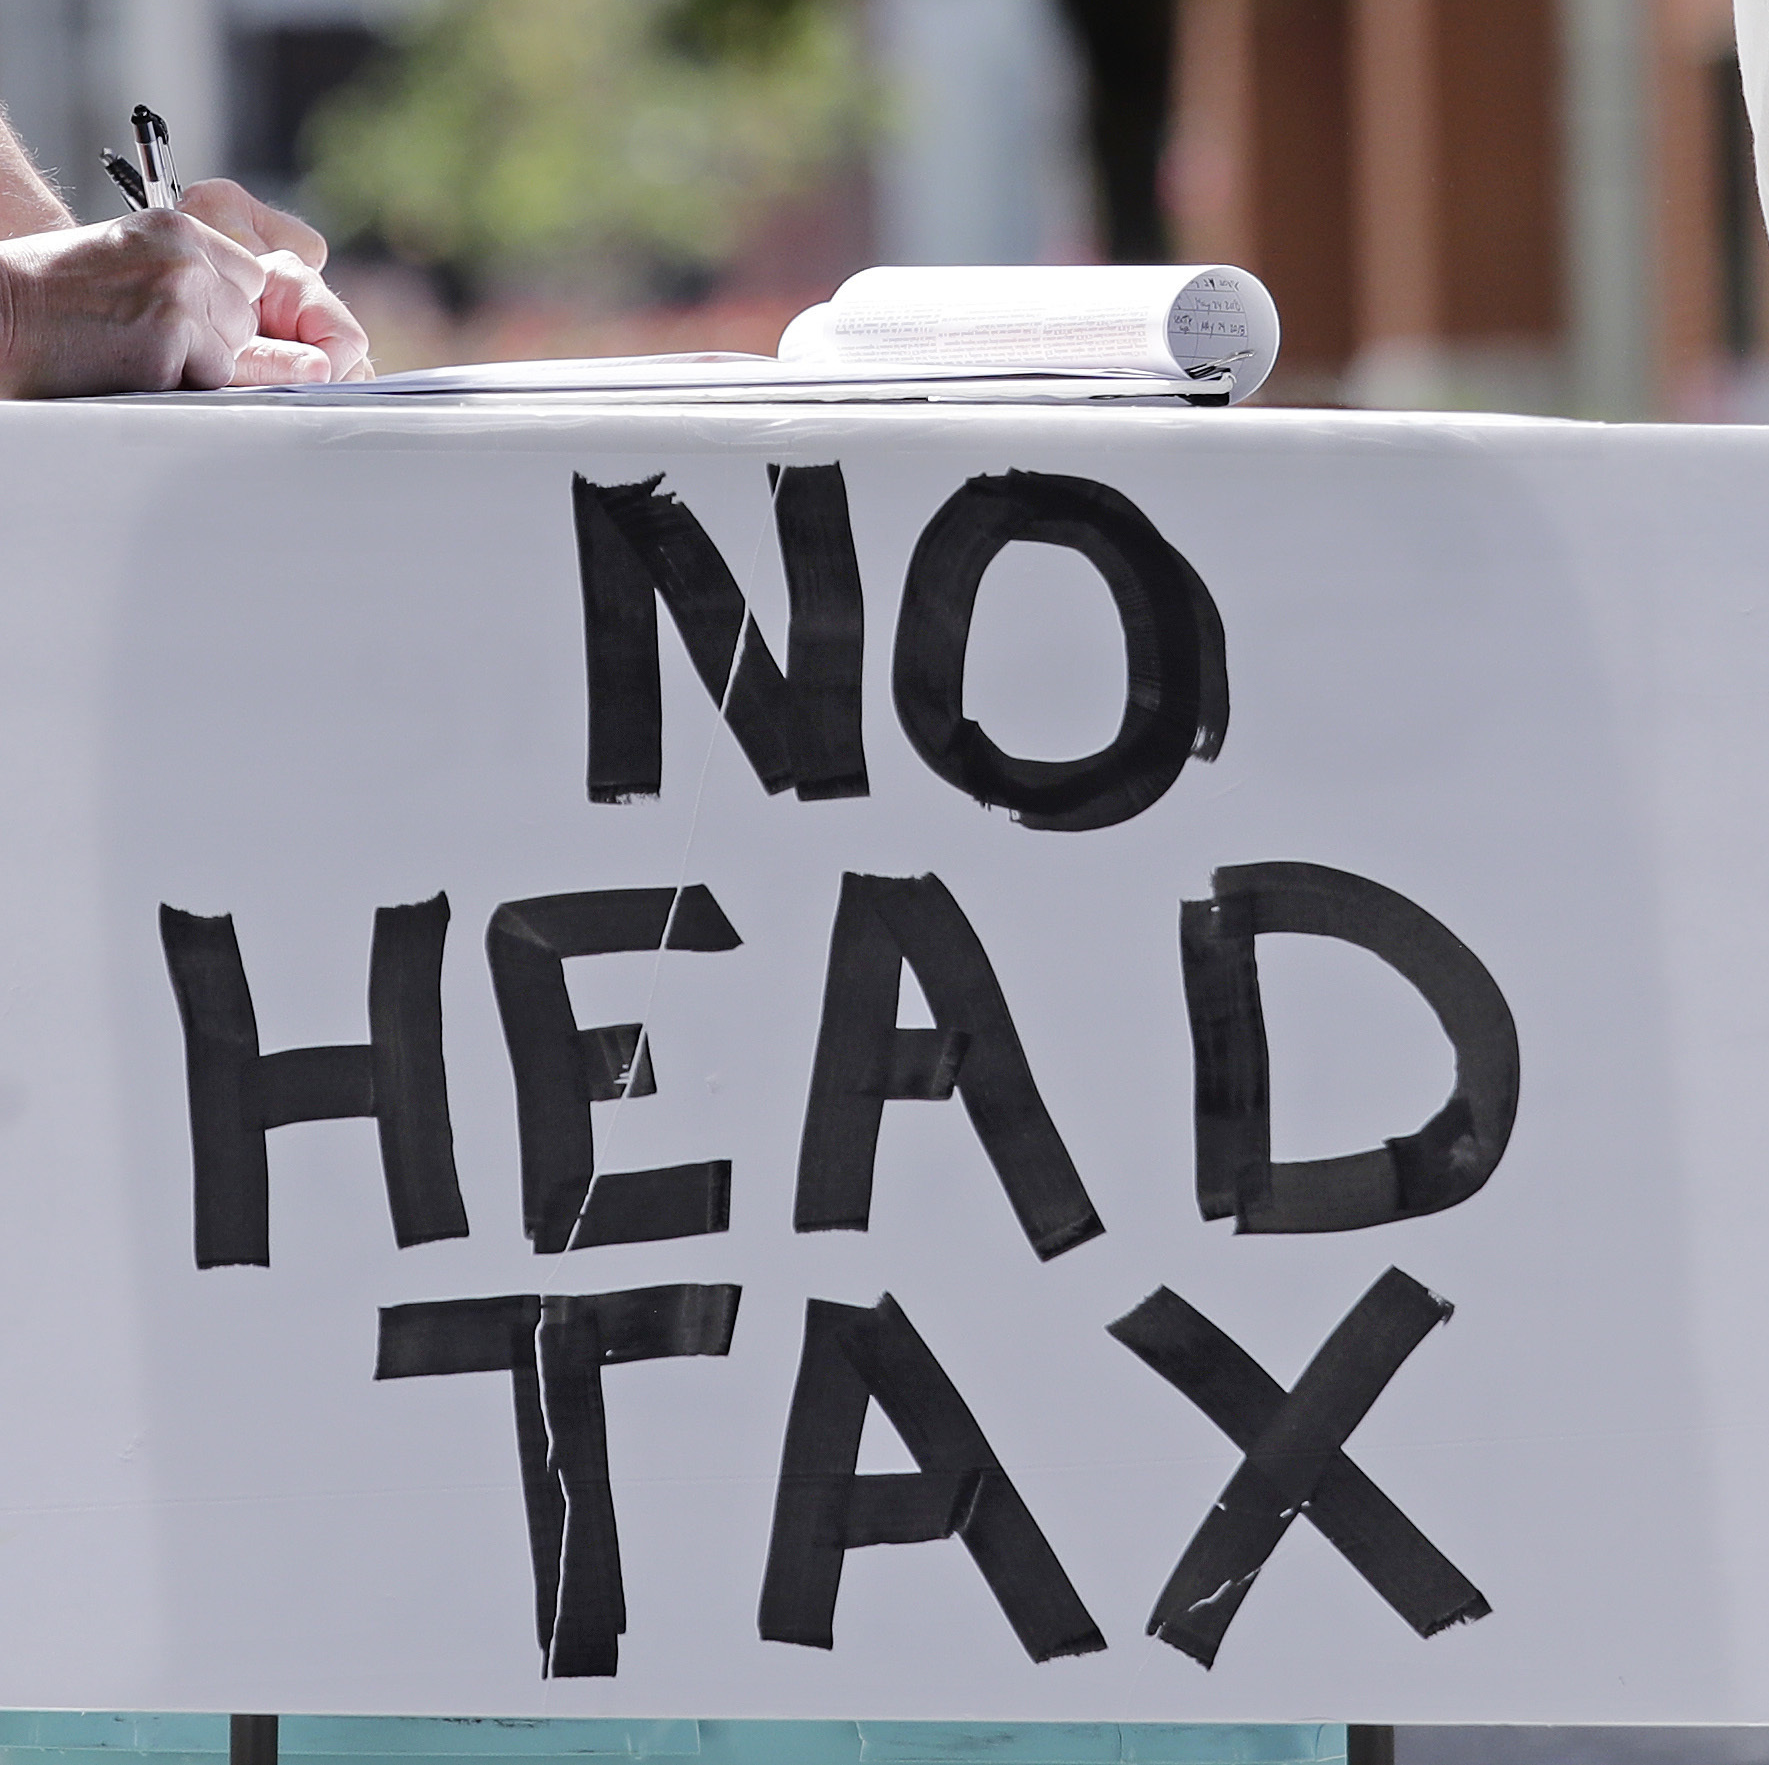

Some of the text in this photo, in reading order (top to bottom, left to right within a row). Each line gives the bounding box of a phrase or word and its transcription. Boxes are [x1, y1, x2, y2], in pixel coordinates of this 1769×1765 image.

[572, 461, 1230, 832] NO
[160, 862, 1520, 1269] HEAD
[374, 1266, 1492, 1680] TAX
